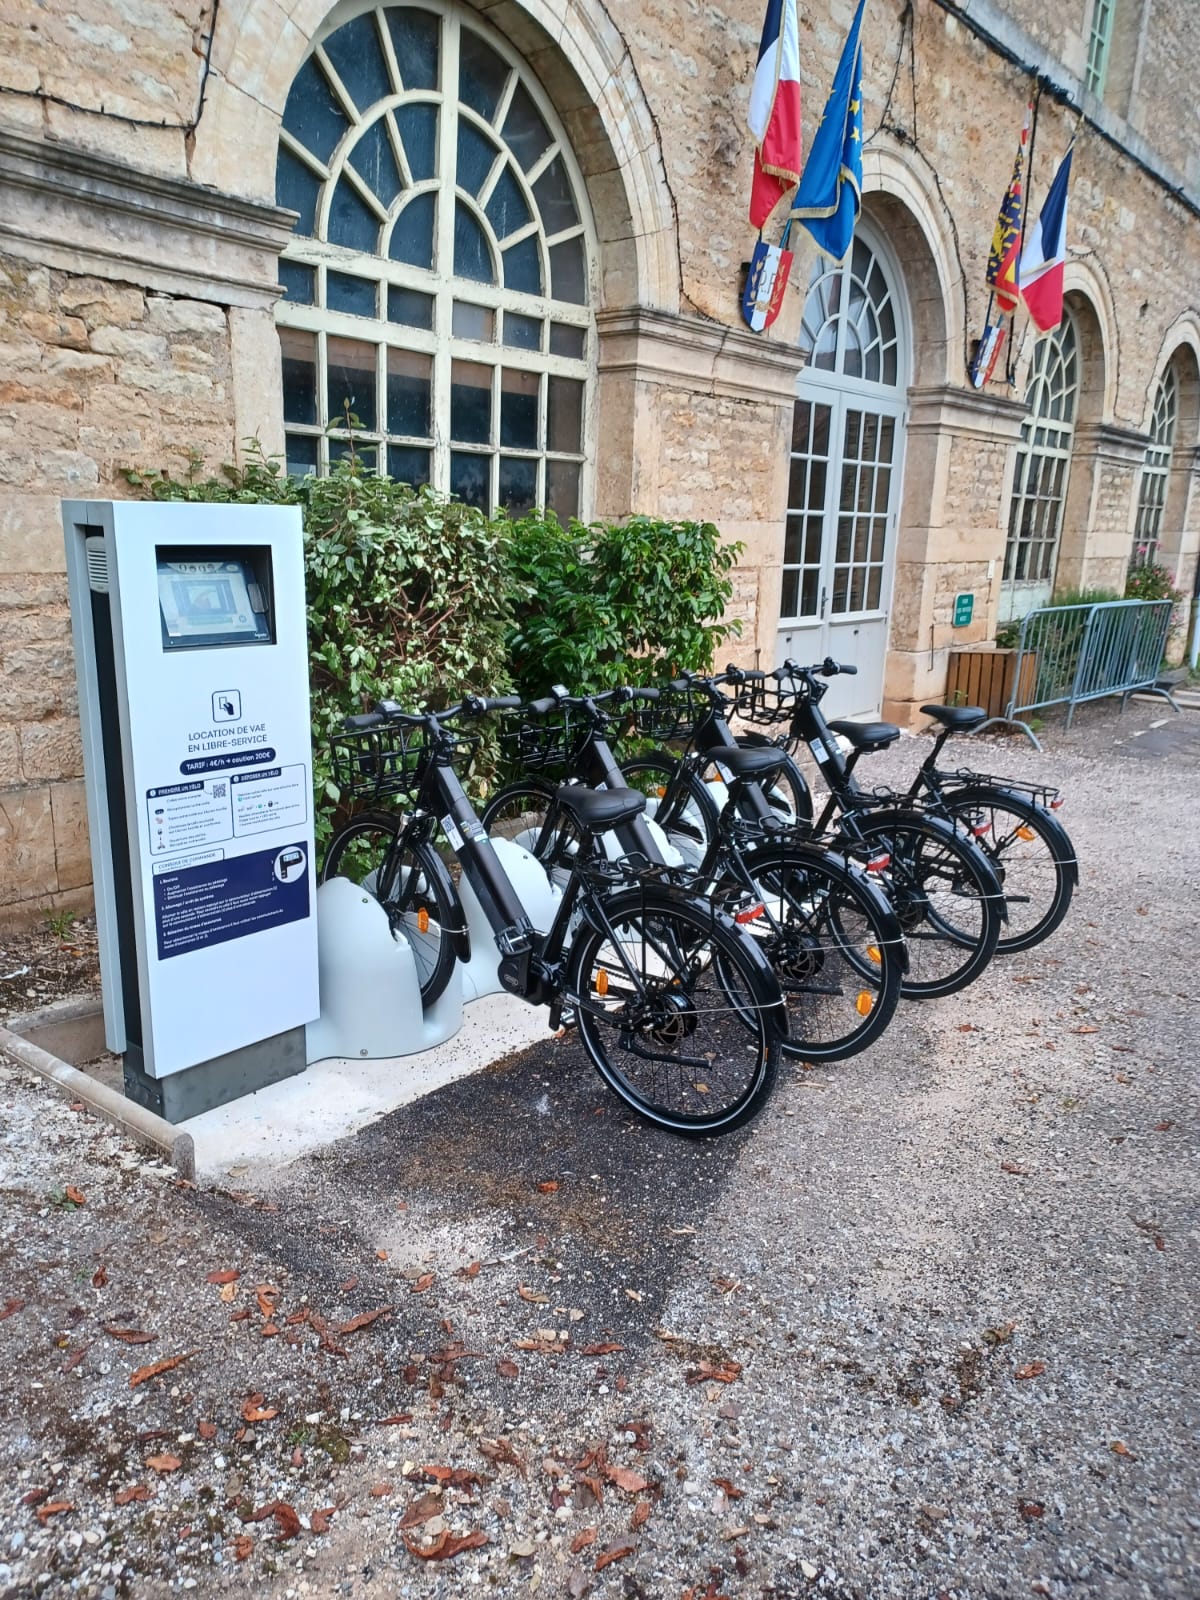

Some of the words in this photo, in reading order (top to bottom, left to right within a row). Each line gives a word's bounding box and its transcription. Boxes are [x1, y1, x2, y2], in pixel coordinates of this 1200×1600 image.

[188, 727, 235, 741] LOCATION
[237, 725, 248, 735] DE
[249, 723, 266, 733] VAE
[188, 743, 200, 753] EN
[202, 734, 268, 751] LIBRE-SERVICE
[186, 761, 206, 771] TARIF
[209, 758, 225, 767] 4€/h
[232, 754, 255, 764] caution
[255, 751, 271, 760] 200€
